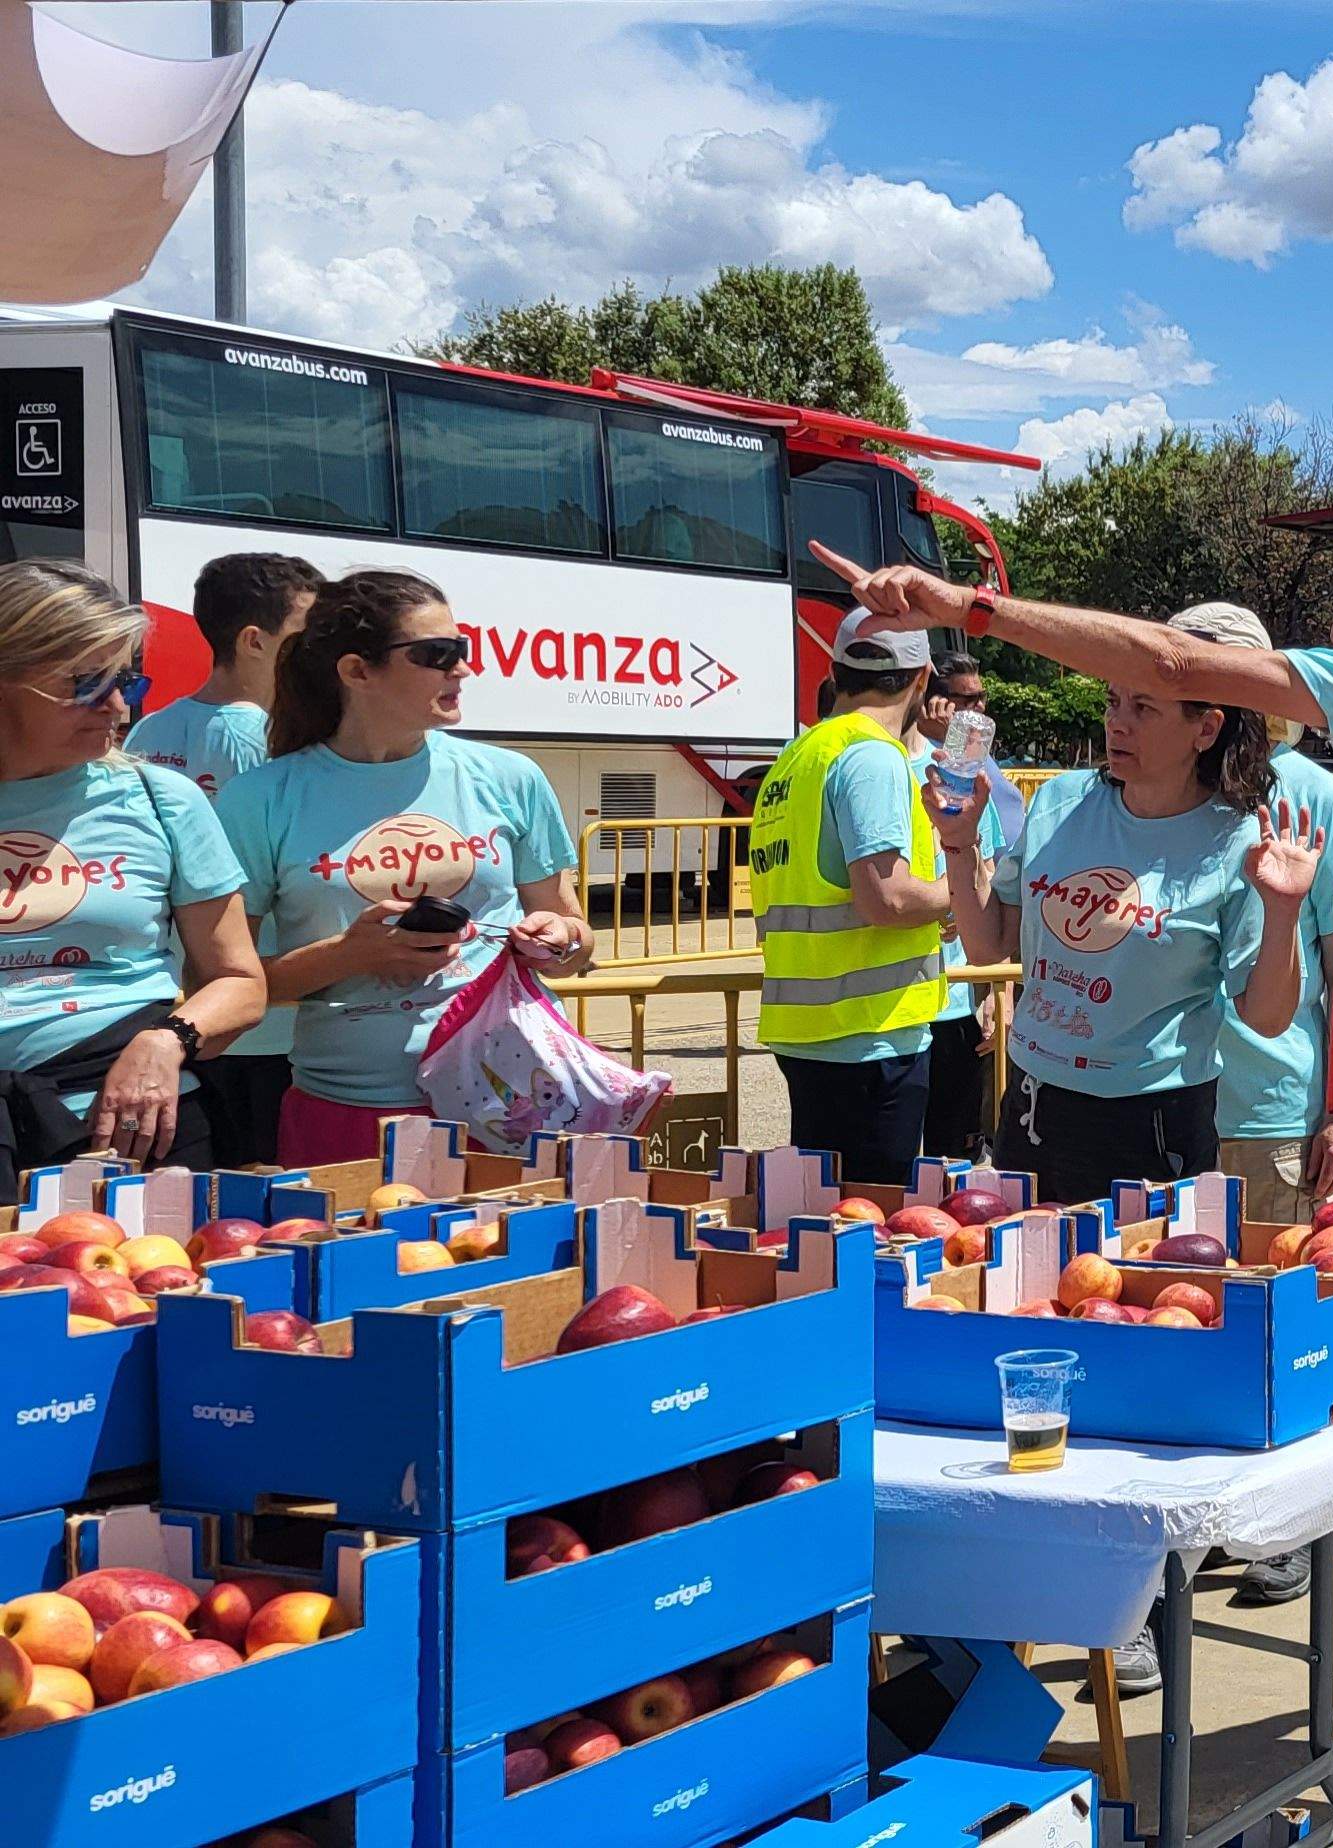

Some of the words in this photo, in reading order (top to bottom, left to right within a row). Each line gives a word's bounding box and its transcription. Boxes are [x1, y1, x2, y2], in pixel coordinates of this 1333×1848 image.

[224, 348, 368, 386] avanzabus.com
[18, 403, 57, 414] ACCESO
[662, 423, 763, 451] avanzabus.com
[1, 495, 62, 509] avanza
[568, 692, 579, 705] BY
[580, 689, 650, 707] MOBILITY
[654, 692, 683, 708] ADO
[2, 855, 129, 909] yores
